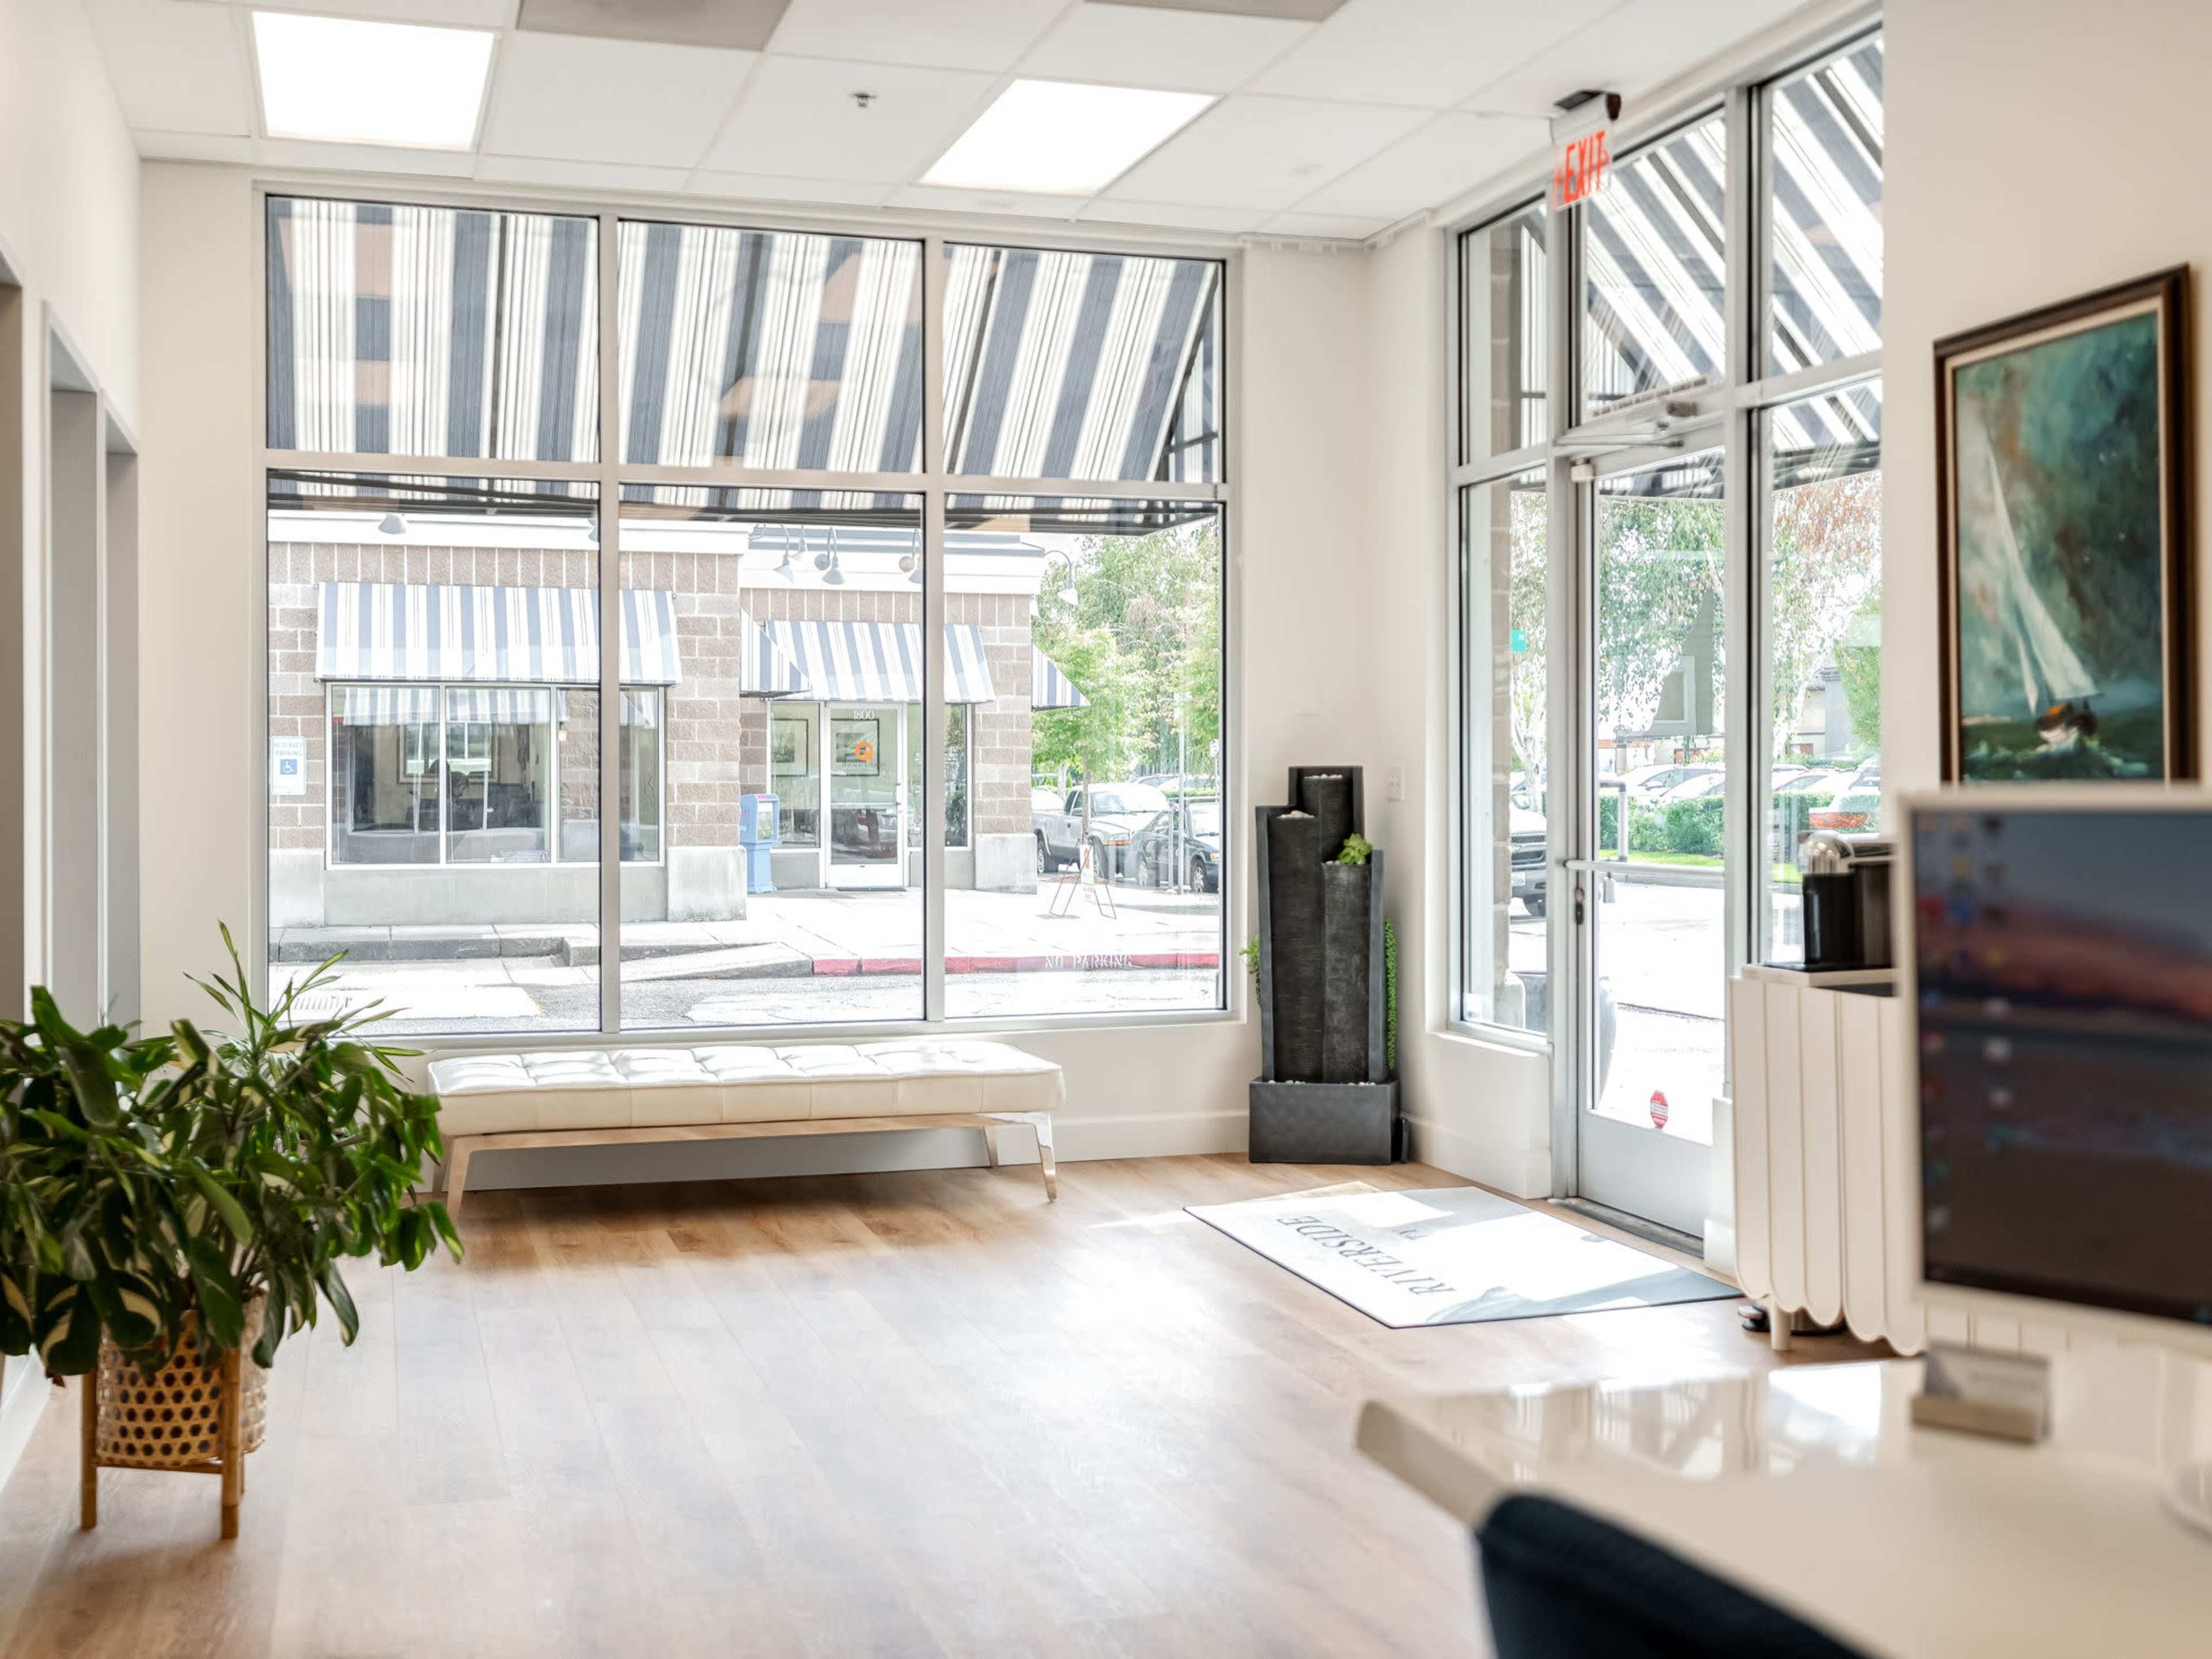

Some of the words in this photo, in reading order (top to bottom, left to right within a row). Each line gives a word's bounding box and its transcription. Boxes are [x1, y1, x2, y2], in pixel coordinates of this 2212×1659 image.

[1563, 130, 1605, 203] EXIT
[853, 709, 874, 719] 1800
[1046, 955, 1063, 968] NO
[1073, 954, 1132, 968] PARKING
[1277, 1215, 1457, 1294] RIVERSIDE
